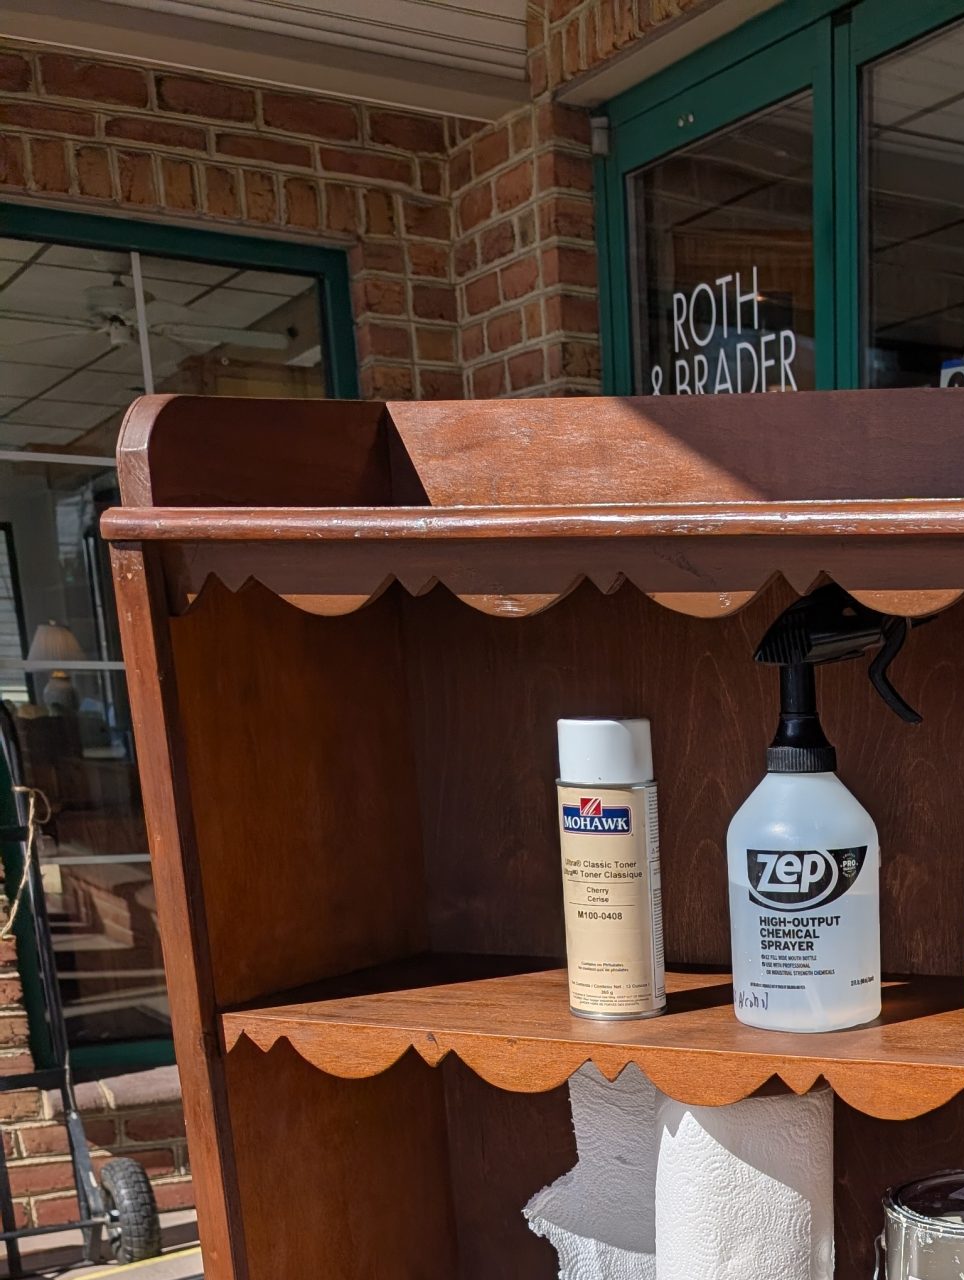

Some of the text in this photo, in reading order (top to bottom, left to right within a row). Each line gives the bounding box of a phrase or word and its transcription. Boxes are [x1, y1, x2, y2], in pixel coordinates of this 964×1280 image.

[673, 266, 758, 353] ROTH
[563, 815, 629, 830] MOHAWK
[583, 860, 612, 868] Classic
[614, 860, 637, 868] Toner
[580, 870, 602, 878] Toner
[604, 871, 643, 879] Classique
[586, 886, 609, 895] Cherry
[578, 911, 623, 920] M100-0408
[759, 916, 841, 927] HIGH-OUTPUT
[760, 928, 820, 939] CHEMICAL
[761, 940, 814, 951] SPRAYER
